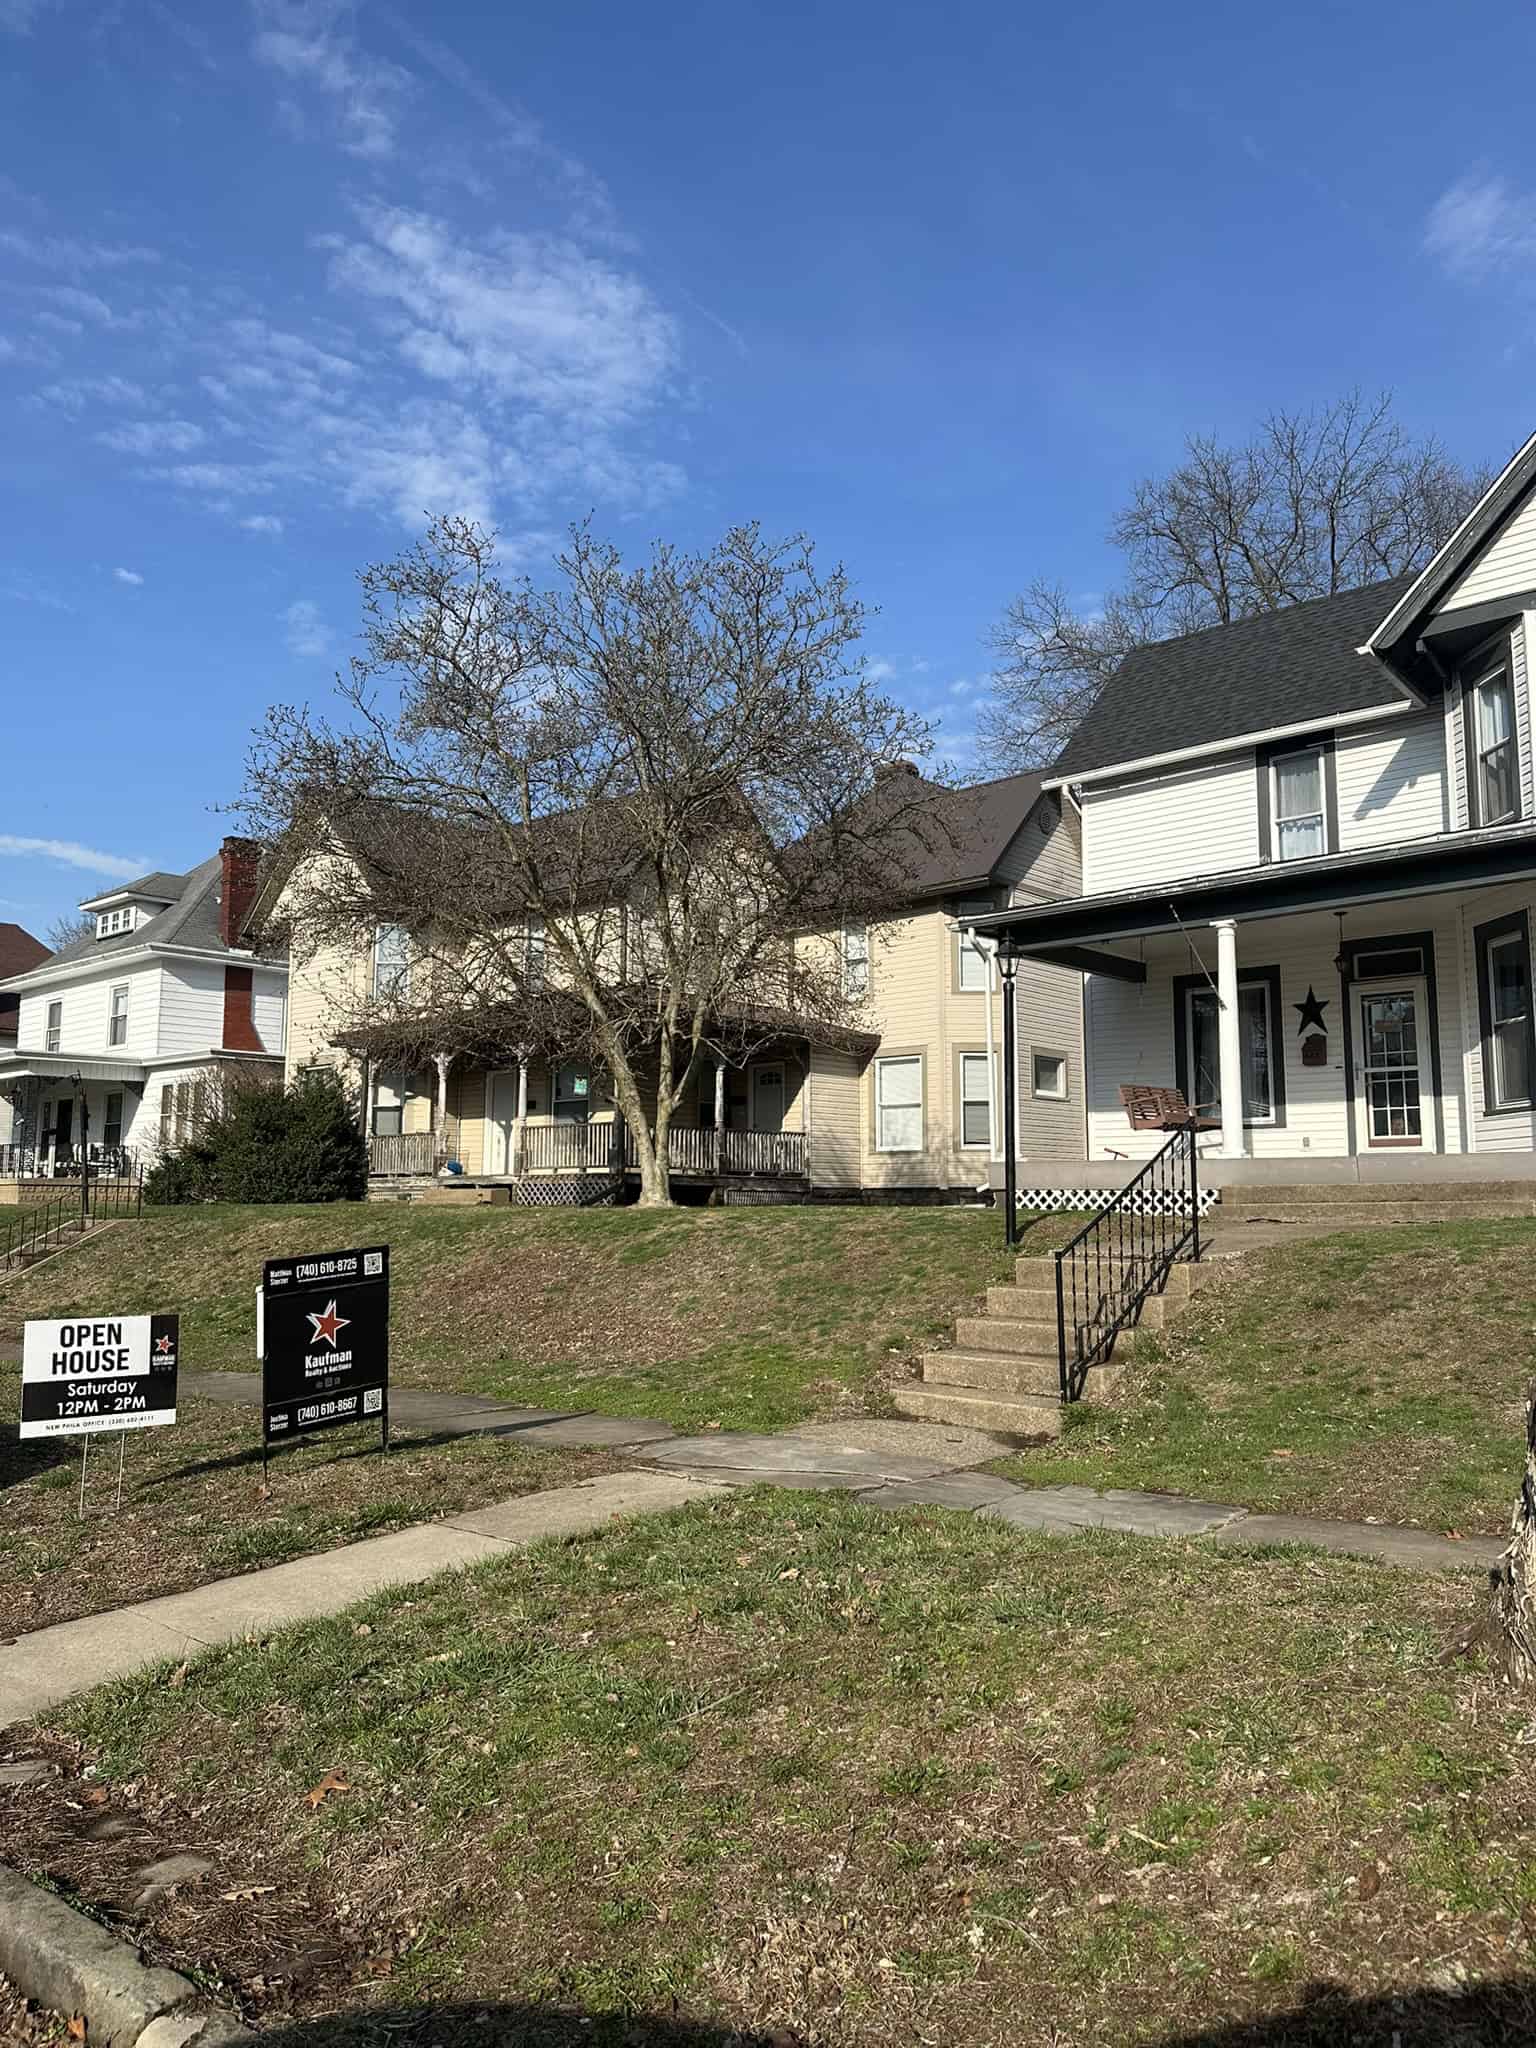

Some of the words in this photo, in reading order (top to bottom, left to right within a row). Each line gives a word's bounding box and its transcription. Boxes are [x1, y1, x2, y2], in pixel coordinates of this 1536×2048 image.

[296, 1263, 319, 1279] (740)
[320, 1257, 358, 1275] 610-8725
[60, 1323, 122, 1348] OPEN
[52, 1348, 130, 1375] HOUSE
[304, 1350, 352, 1369] Kaufman
[67, 1380, 137, 1397] Saturday
[57, 1399, 99, 1416] 12PM
[114, 1396, 146, 1411] 2PM
[297, 1404, 319, 1422] (740)
